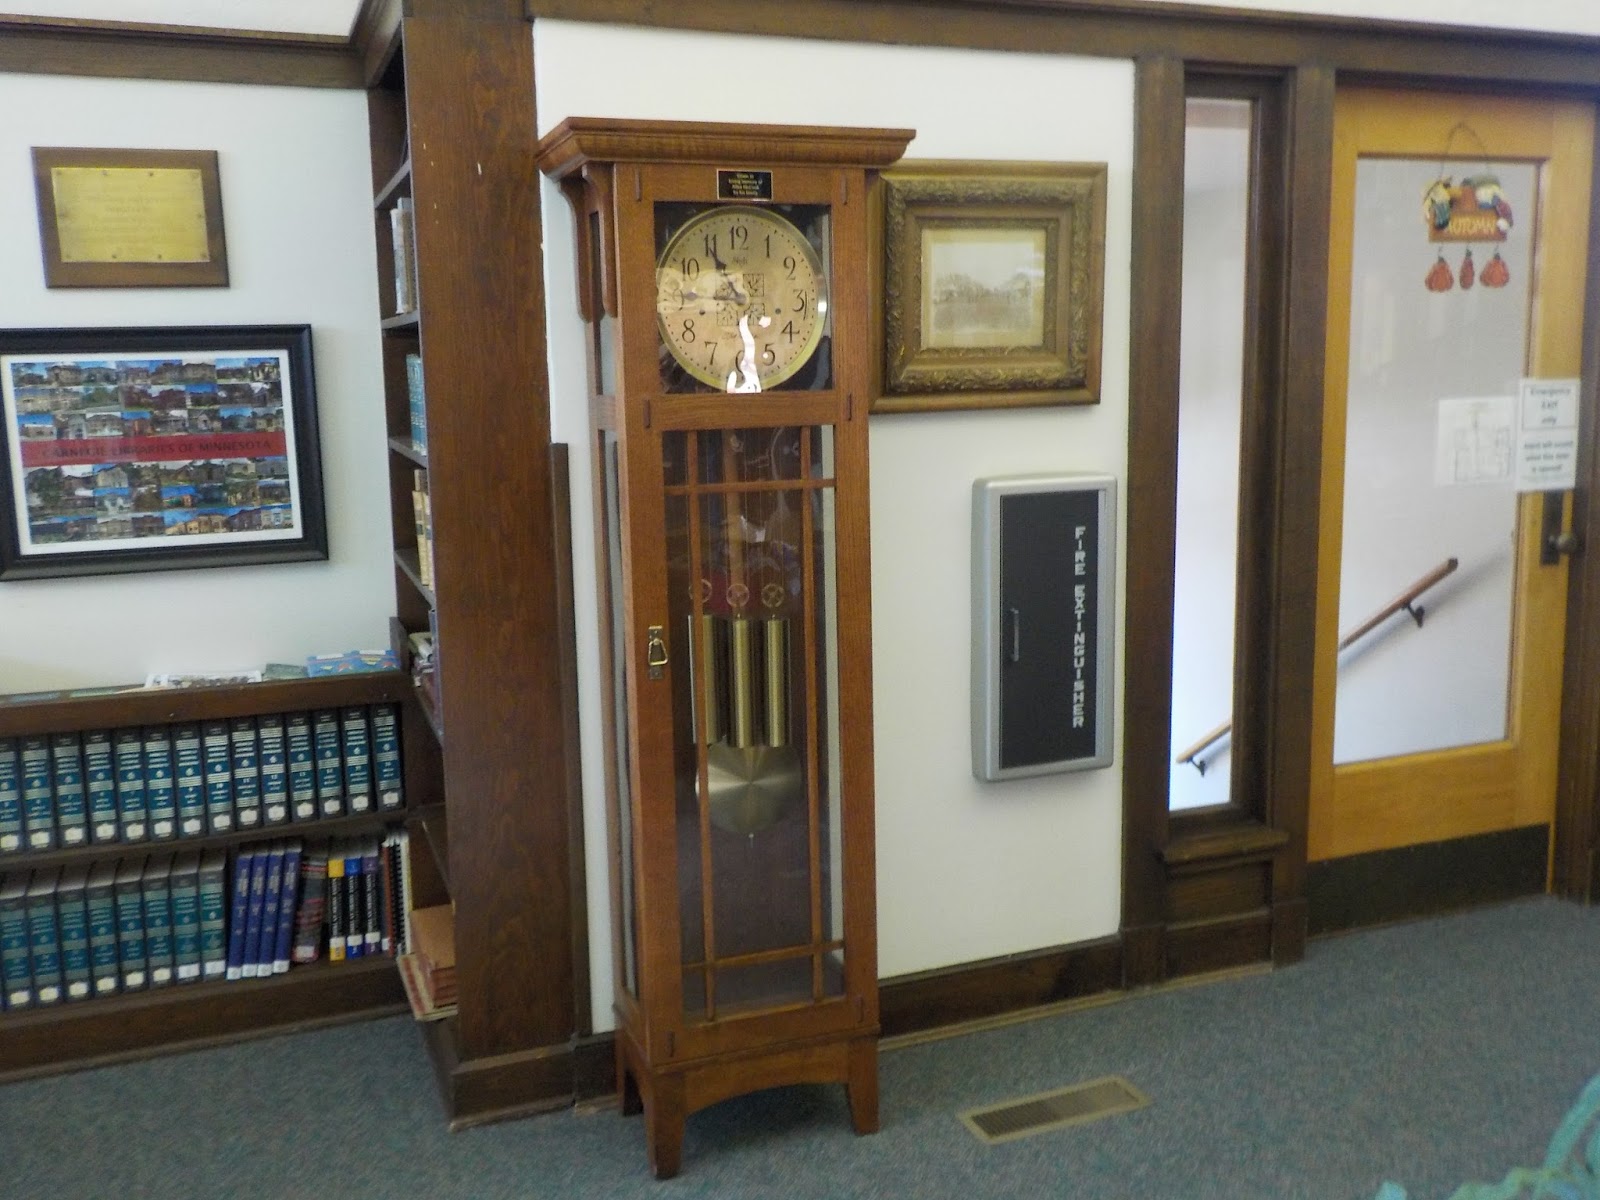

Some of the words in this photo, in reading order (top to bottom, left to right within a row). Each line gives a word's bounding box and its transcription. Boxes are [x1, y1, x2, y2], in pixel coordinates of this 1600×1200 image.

[704, 234, 718, 257] 11
[729, 225, 748, 250] 12
[764, 235, 771, 258] 1
[681, 258, 700, 281] 10
[783, 257, 796, 280] 2
[793, 289, 805, 312] 3
[682, 319, 696, 343] 8
[781, 320, 800, 343] 4
[704, 341, 718, 365] 7
[763, 343, 775, 366] 5
[178, 442, 194, 453] OF
[199, 440, 272, 452] MINNESOTA
[1074, 526, 1086, 576] FIRE
[1072, 584, 1086, 729] EXTINGUISHER
